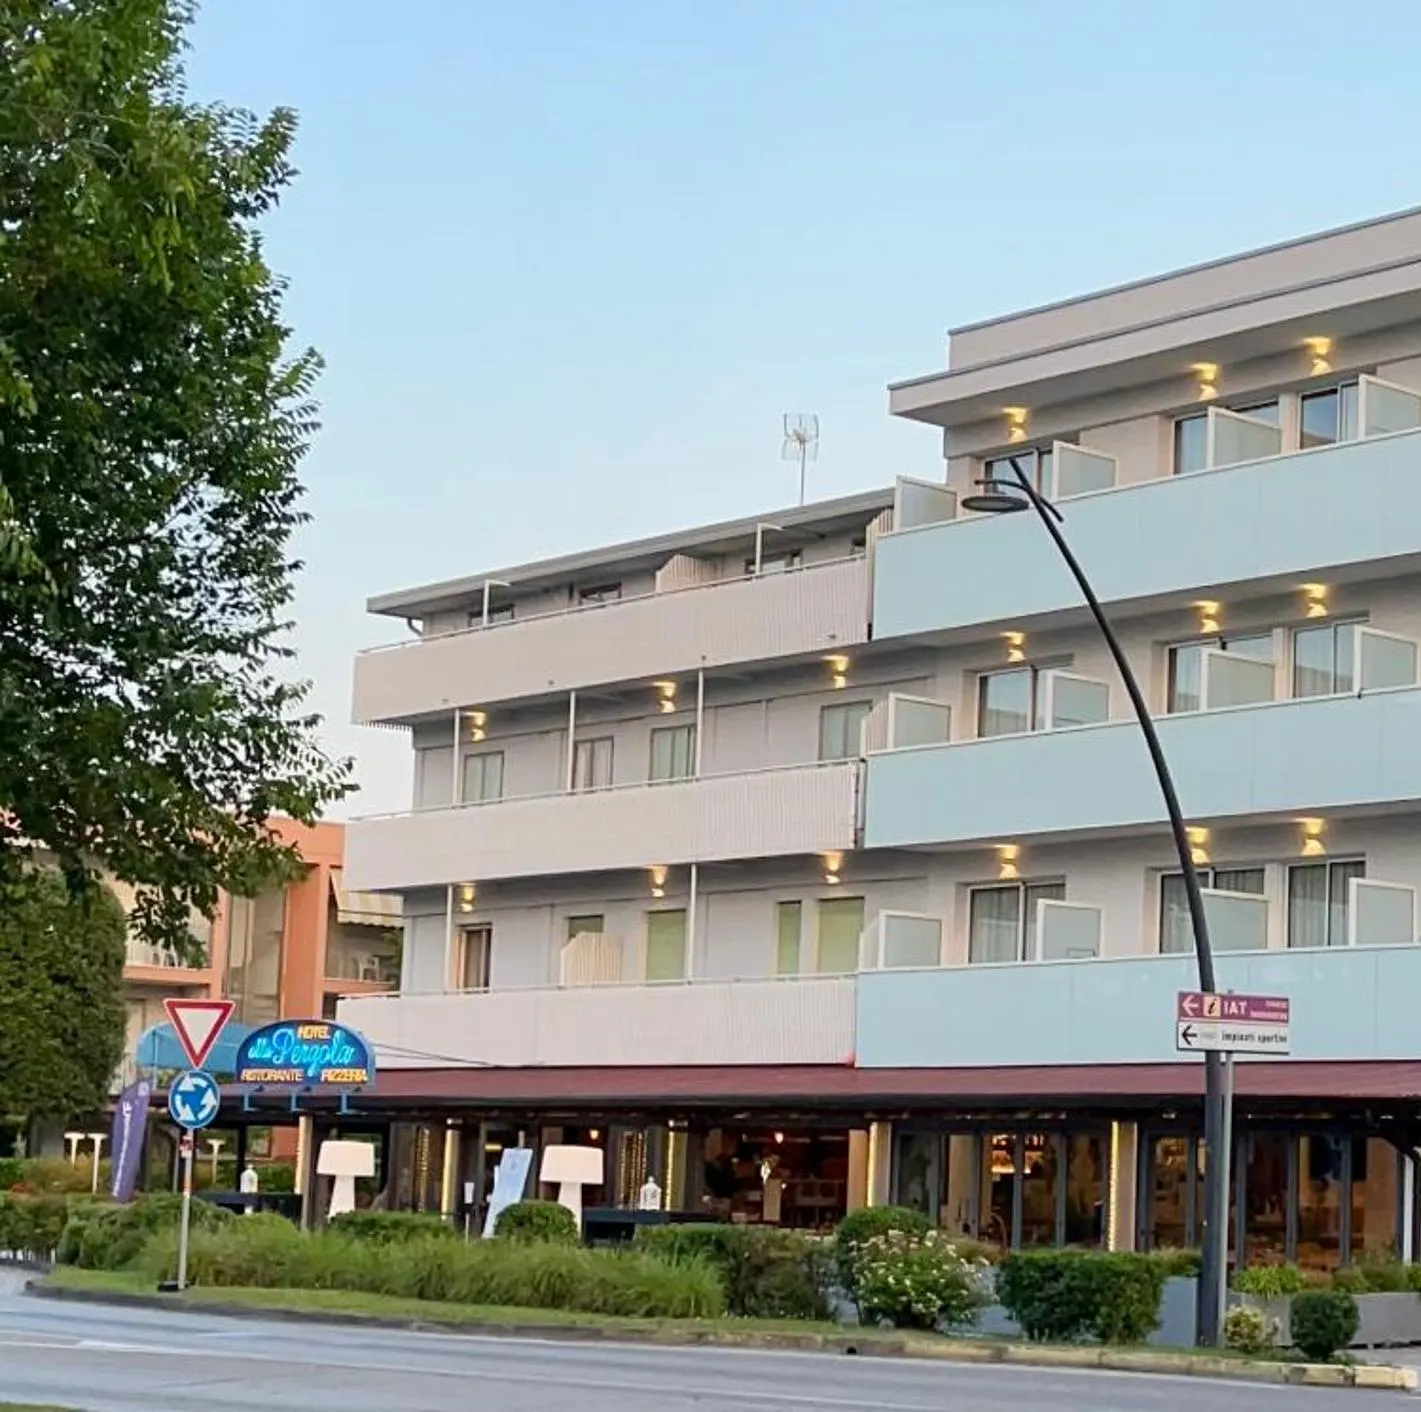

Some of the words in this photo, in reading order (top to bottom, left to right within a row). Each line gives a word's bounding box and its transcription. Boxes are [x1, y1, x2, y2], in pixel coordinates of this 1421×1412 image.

[1223, 1000, 1248, 1015] IAT
[297, 1025, 332, 1039] HOTEL
[272, 1028, 355, 1077] Pergola
[240, 1068, 305, 1082] RISTORANTE
[321, 1068, 369, 1082] PIZZERIA
